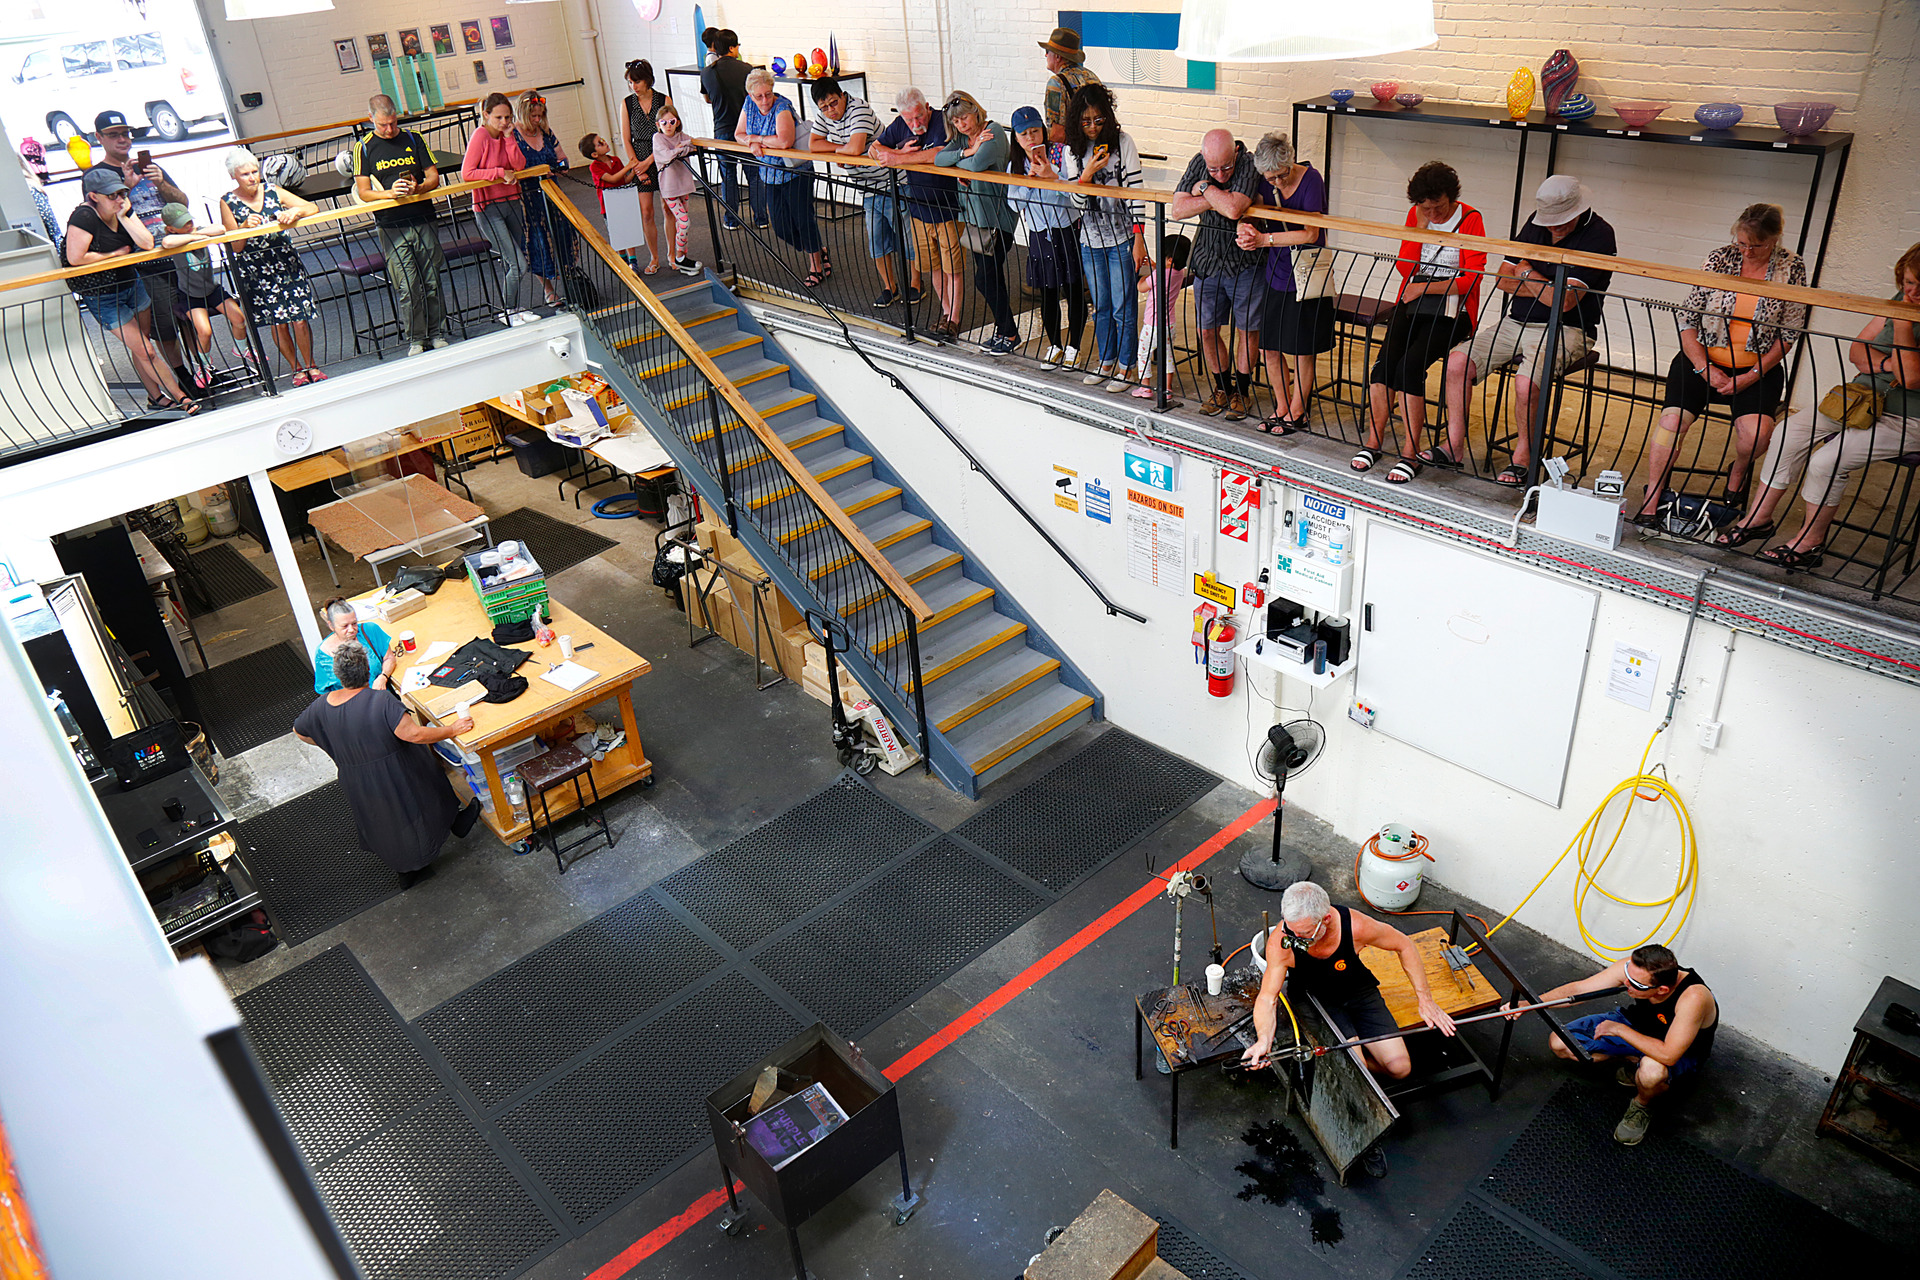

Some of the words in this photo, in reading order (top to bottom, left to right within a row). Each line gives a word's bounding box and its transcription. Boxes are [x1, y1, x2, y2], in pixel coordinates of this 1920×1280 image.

[376, 155, 416, 171] #boost
[465, 435, 481, 444] MADE
[1095, 487, 1108, 495] ACTION
[1129, 491, 1156, 509] HAZARDS
[1158, 501, 1167, 512] ON
[1169, 504, 1183, 518] SITE
[1305, 497, 1344, 518] NOTICE
[1308, 521, 1327, 532] MUST
[1294, 569, 1314, 580] Medical
[1314, 577, 1333, 587] Cabinet
[1303, 567, 1315, 576] First
[1202, 583, 1227, 595] EMERGENCY
[1210, 590, 1228, 601] SHUT-OFF
[874, 719, 897, 752] MERTON
[774, 1108, 808, 1147] PURPLE
